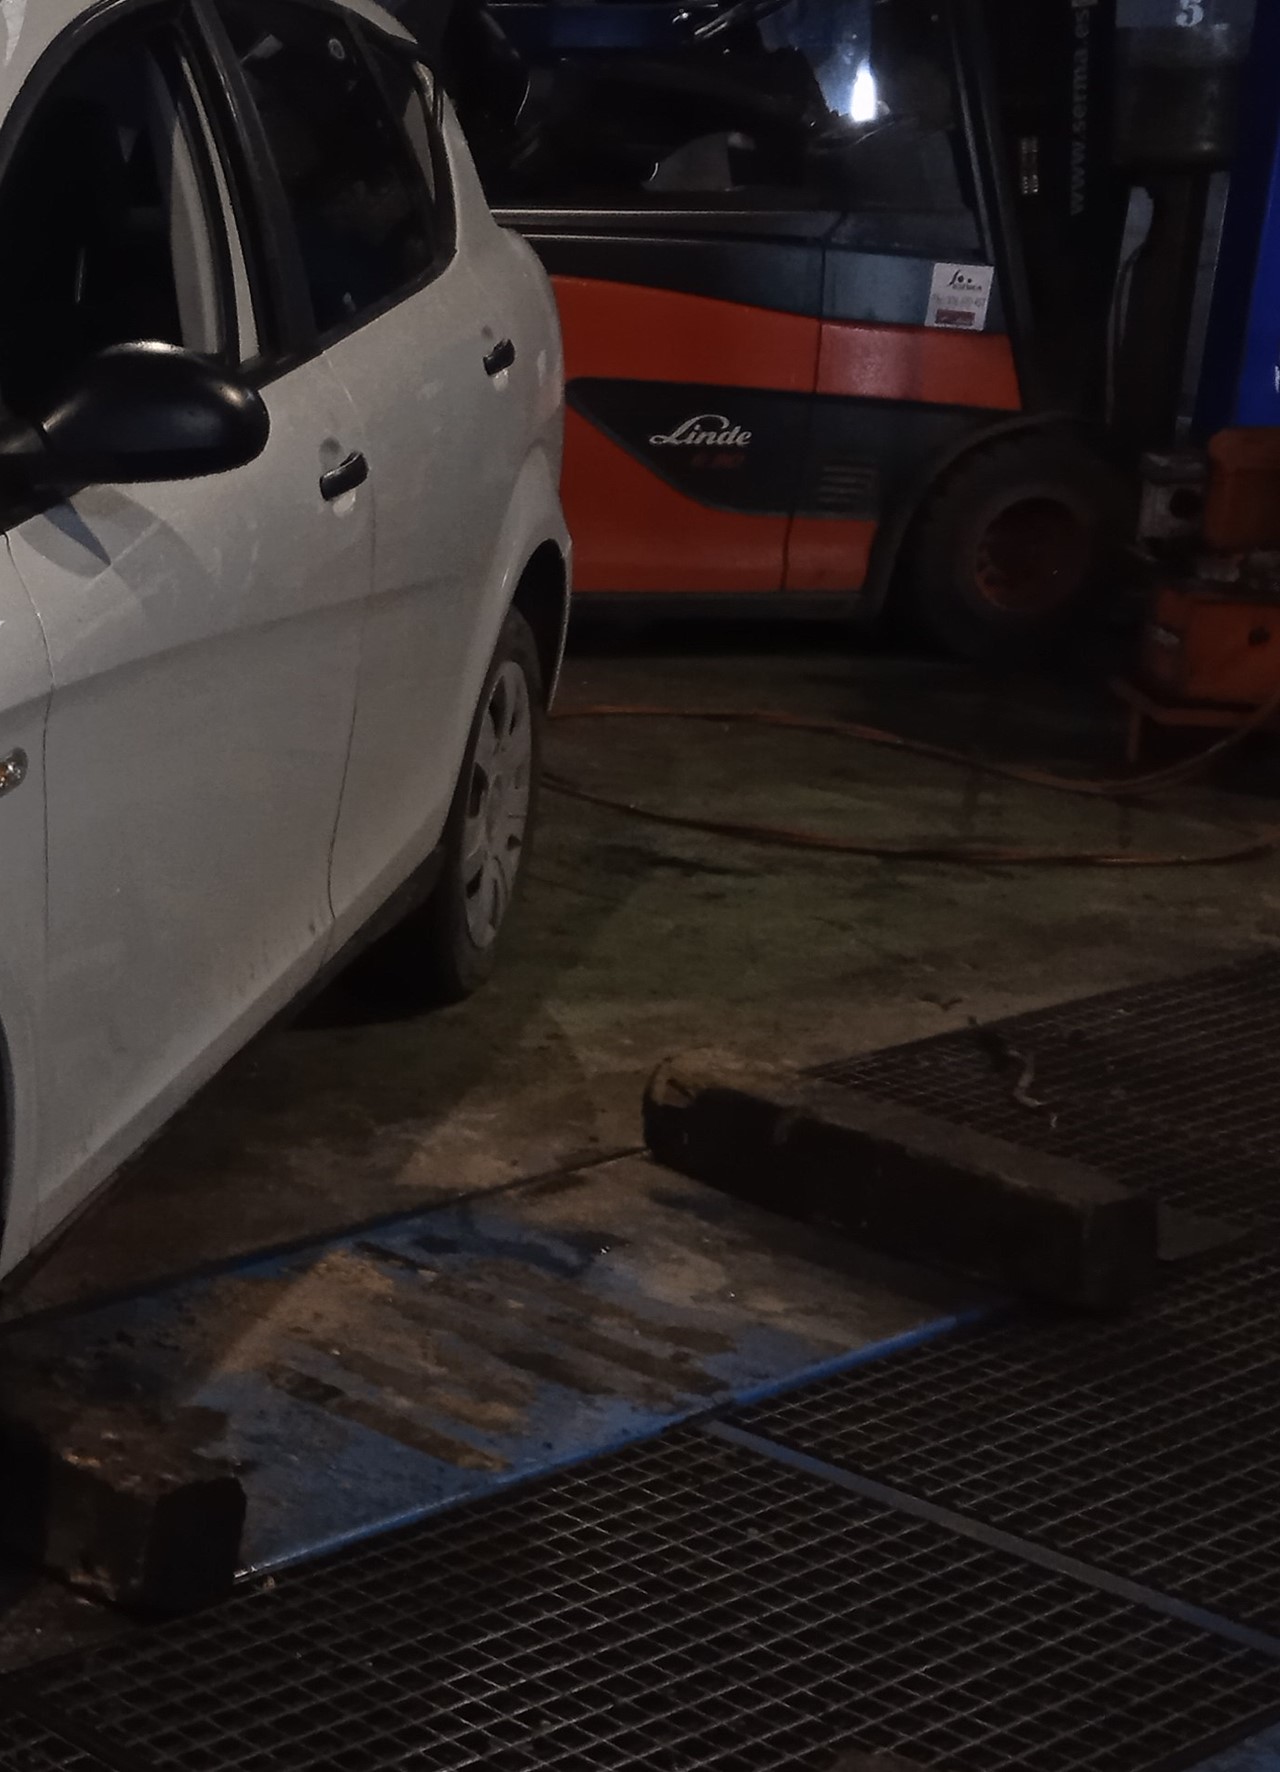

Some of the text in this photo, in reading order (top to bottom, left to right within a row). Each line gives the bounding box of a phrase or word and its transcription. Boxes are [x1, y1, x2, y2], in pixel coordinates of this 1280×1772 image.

[1176, 0, 1204, 27] 5
[1070, 9, 1090, 216] www.serma.es
[649, 414, 753, 446] Linde
